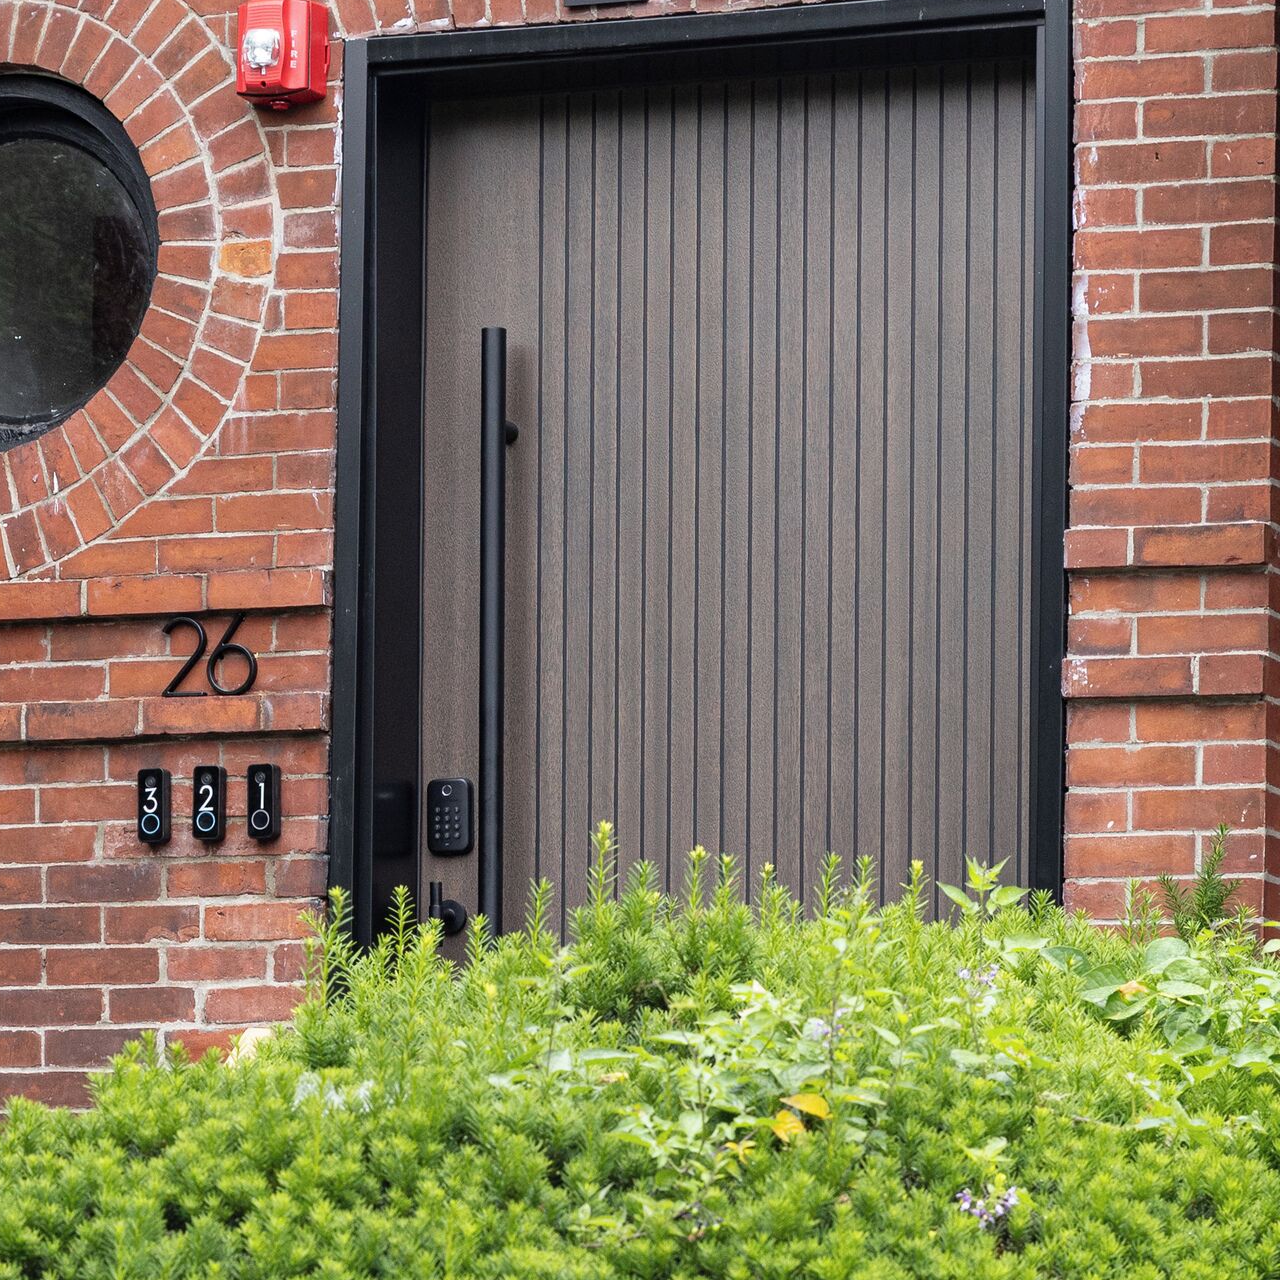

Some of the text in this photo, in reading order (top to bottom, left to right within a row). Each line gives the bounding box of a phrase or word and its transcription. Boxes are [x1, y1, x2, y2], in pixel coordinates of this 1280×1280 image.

[290, 29, 298, 69] FIRE
[162, 611, 258, 697] 26
[143, 787, 158, 813] 3
[199, 785, 214, 811] 2
[258, 782, 265, 809] 1
